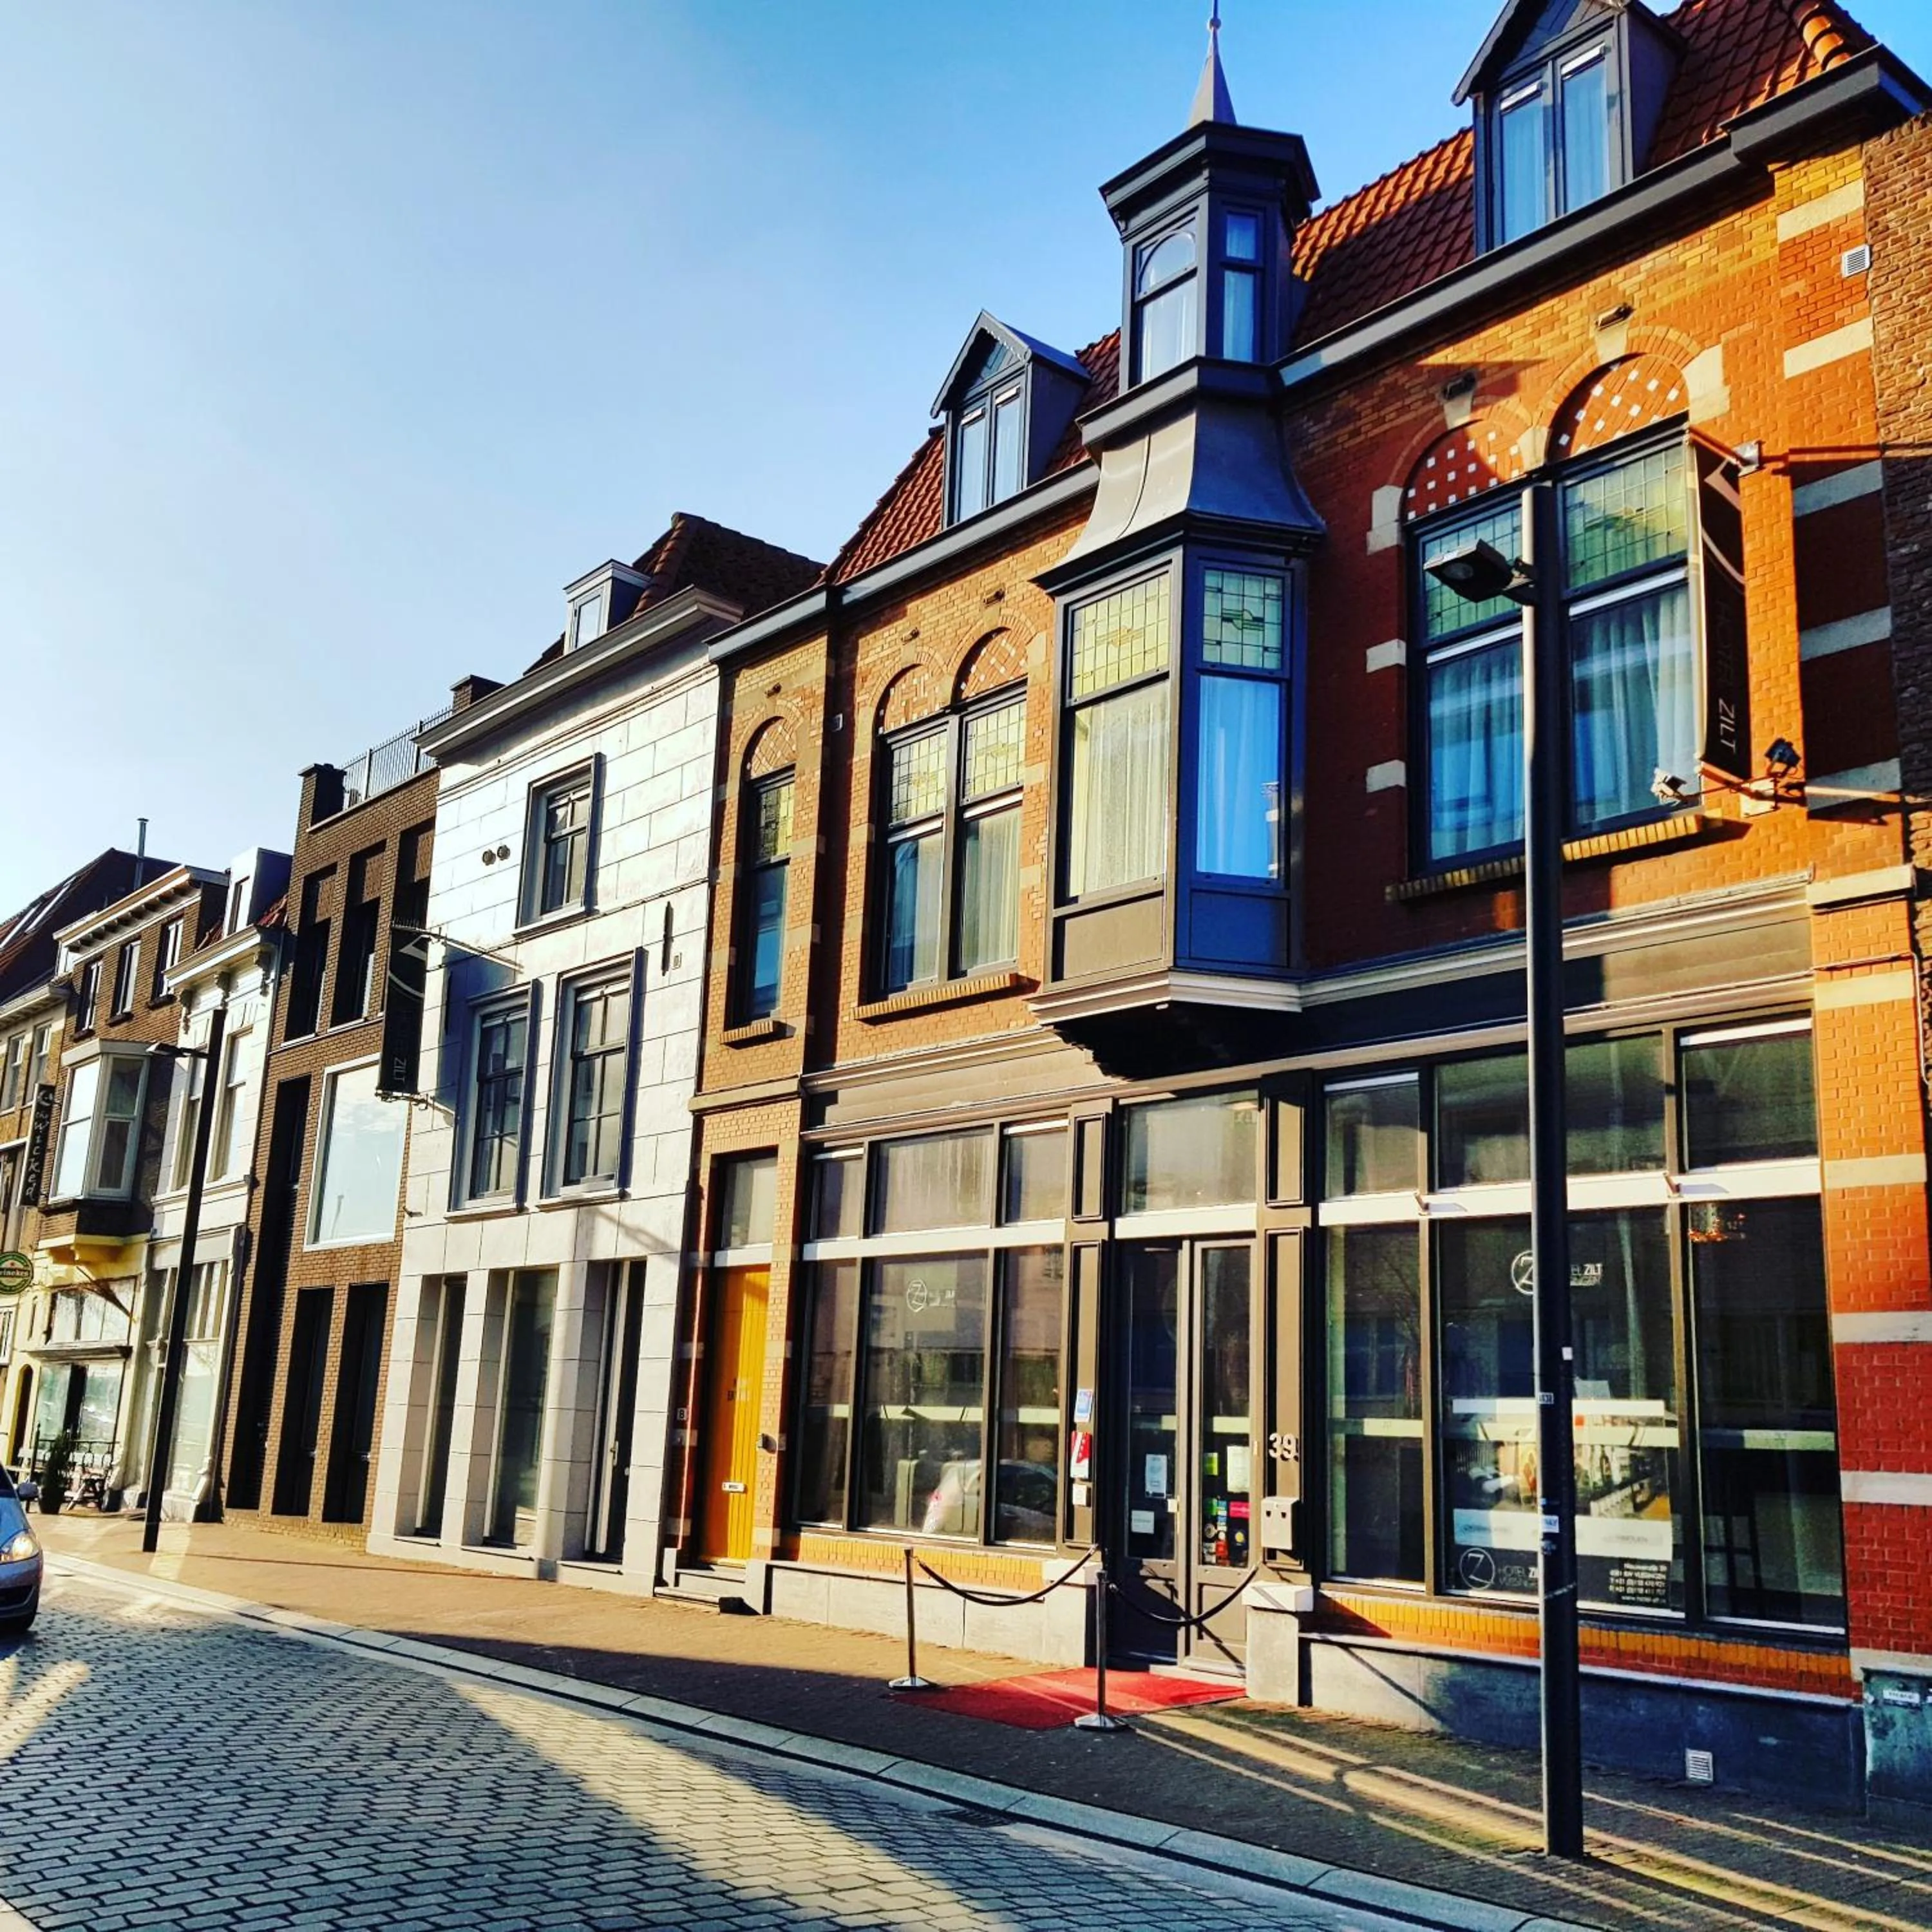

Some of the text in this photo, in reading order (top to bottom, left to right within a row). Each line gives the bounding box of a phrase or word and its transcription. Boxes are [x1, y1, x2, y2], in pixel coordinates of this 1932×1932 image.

[1718, 697, 1736, 754] ZILT
[393, 1057, 407, 1084] ZILT
[0, 1268, 29, 1277] eineken
[1584, 1263, 1603, 1275] ZILT
[1268, 1432, 1296, 1458] 39
